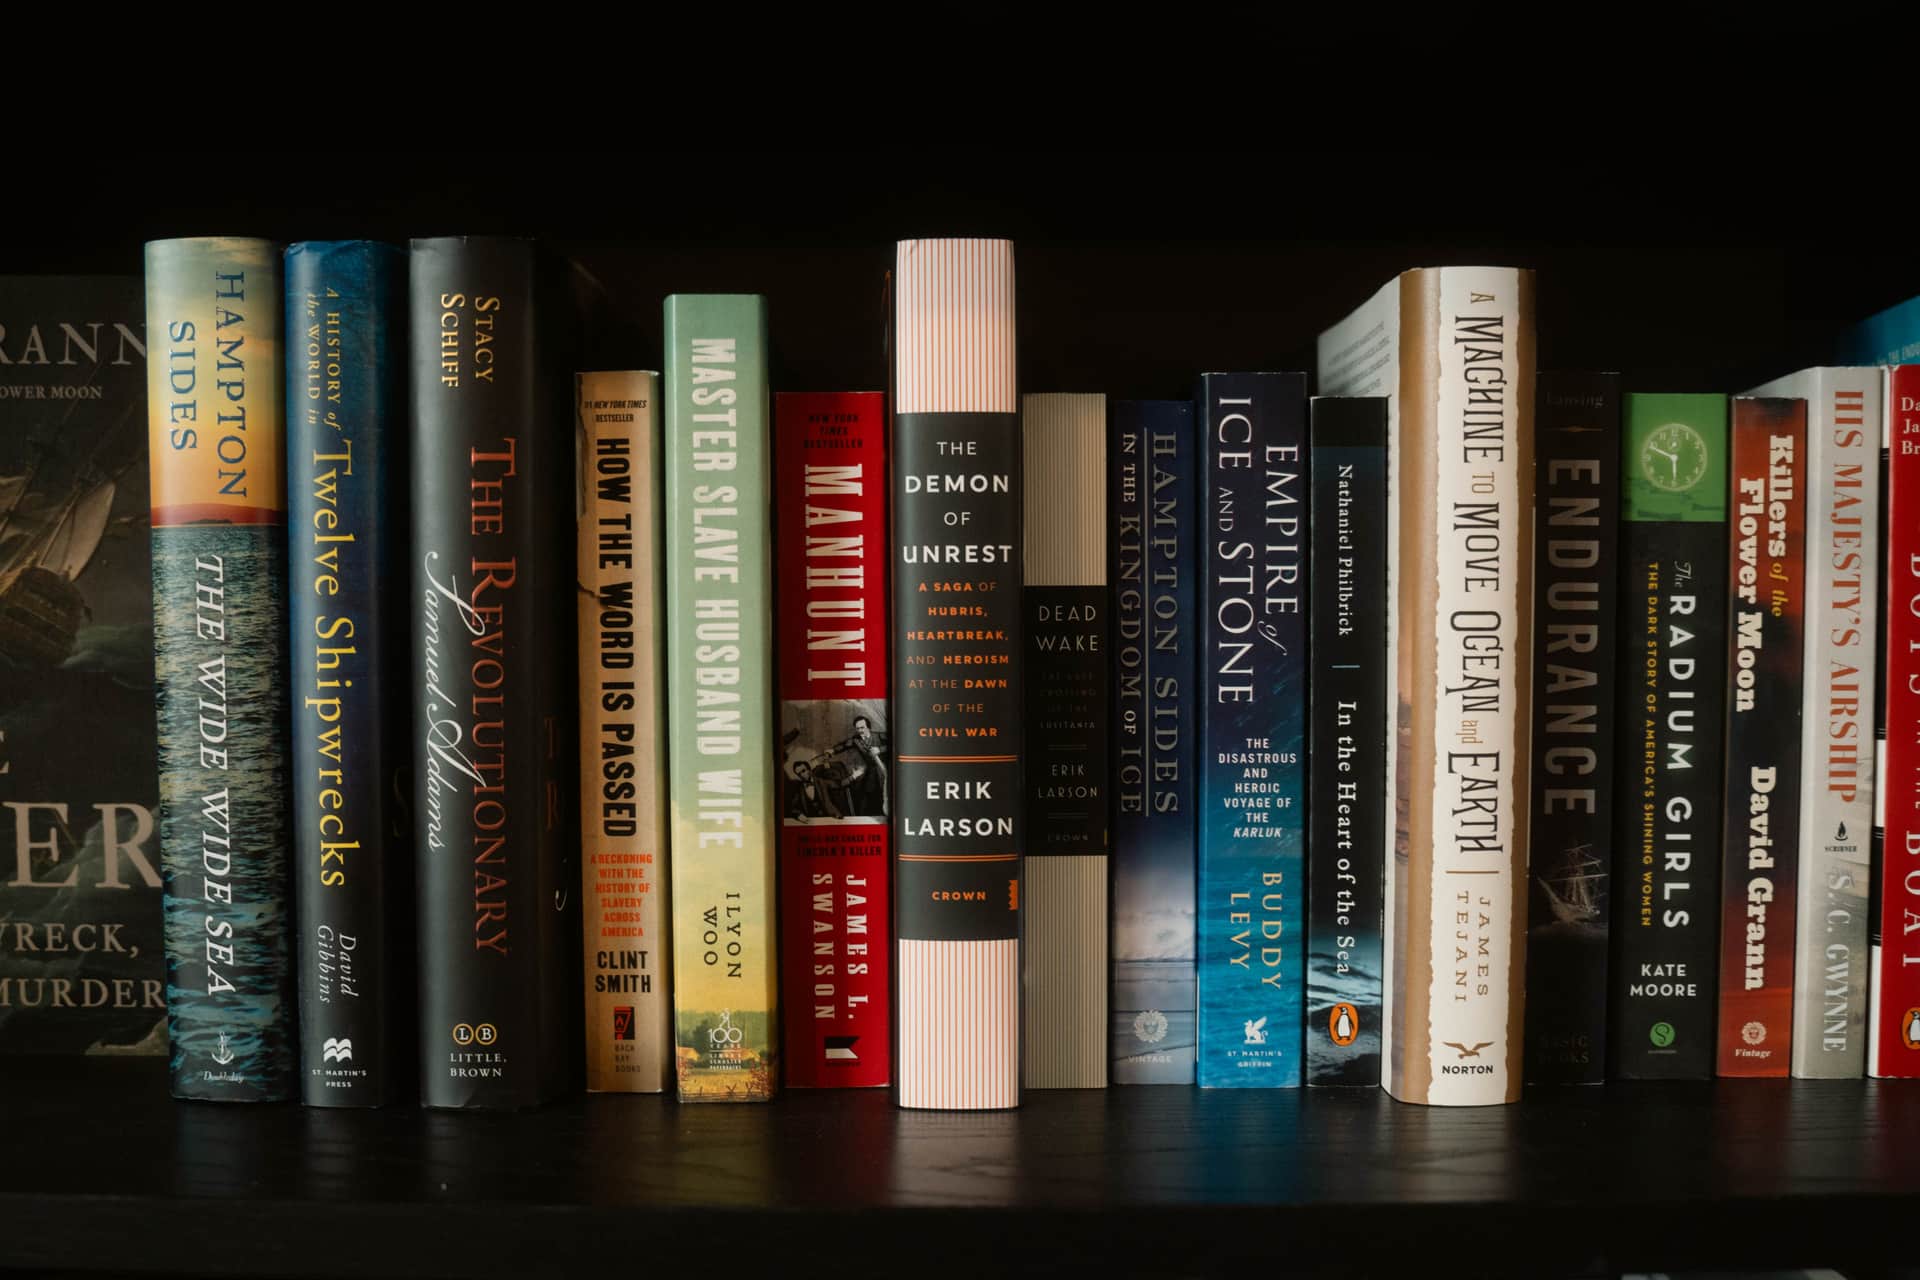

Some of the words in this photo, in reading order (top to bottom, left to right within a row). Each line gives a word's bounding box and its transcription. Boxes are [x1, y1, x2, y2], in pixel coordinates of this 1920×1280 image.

[307, 293, 316, 316] the
[327, 288, 339, 298] A
[1470, 292, 1495, 304] A
[307, 325, 321, 398] WORLD
[326, 312, 341, 399] HISTORY
[440, 293, 465, 387] SCHIFF
[474, 296, 501, 385] STACY
[51, 386, 103, 400] MOON
[169, 321, 197, 450] SIDES
[215, 271, 247, 497] HAMPTON
[692, 338, 737, 471] MASTER
[1454, 315, 1507, 463] MACHINE
[307, 409, 316, 425] in
[323, 413, 342, 431] of
[1218, 397, 1253, 469] ICE
[1833, 391, 1863, 448] HIS
[936, 442, 977, 455] THE
[1122, 432, 1137, 454] IN
[470, 438, 519, 535] THE
[597, 438, 630, 503] HOW
[904, 474, 1009, 493] DEMON
[1122, 464, 1136, 502] THE
[1471, 472, 1495, 494] TO
[313, 439, 356, 596] Twelve
[1218, 487, 1234, 532] AND
[1338, 464, 1353, 550] Nathaniel
[1769, 435, 1794, 557] Killers
[599, 514, 632, 569] THE
[693, 485, 738, 583] SLAVE
[943, 512, 971, 526] OF
[1265, 445, 1299, 614] EMPIRE
[1739, 478, 1764, 604] Flower
[903, 545, 1013, 563] UNREST
[1152, 432, 1177, 654] HAMPTON
[1453, 502, 1500, 592] MOVE
[1831, 464, 1863, 647] MAJESTY'S
[805, 463, 866, 687] MANHUNT
[918, 582, 927, 592] A
[933, 582, 973, 592] SAGA
[978, 582, 997, 592] OF
[1647, 562, 1659, 590] THE
[1674, 560, 1693, 588] The
[1771, 562, 1789, 582] of
[195, 555, 224, 641] THE
[928, 606, 988, 618] HUBRIS,
[1038, 604, 1097, 622] DEAD
[1120, 515, 1142, 699] KINGDOM
[1338, 558, 1353, 637] Philbrick
[1647, 597, 1658, 634] DARK
[1771, 590, 1789, 617] the
[425, 552, 486, 707] Samuel
[600, 582, 634, 669] WORD
[907, 631, 1009, 641] HEARTBREAK,
[1036, 634, 1099, 652] WAKE
[1217, 542, 1255, 704] STONE
[1257, 620, 1288, 656] of
[1543, 459, 1601, 816] ENDURANCE
[695, 600, 740, 755] HUSBAND
[906, 655, 935, 665] AND
[943, 654, 1009, 665] HEROISM
[1446, 610, 1504, 712] OCEAN
[1647, 641, 1657, 687] STORY
[1737, 612, 1763, 712] Moon
[601, 682, 634, 712] IS
[909, 679, 927, 689] AT
[931, 679, 957, 689] THE
[964, 679, 1008, 689] DAWN
[1646, 694, 1656, 713] OF
[1668, 595, 1697, 770] RADIUM
[198, 654, 228, 770] WIDE
[932, 703, 950, 713] OF
[957, 703, 984, 713] THE
[1122, 710, 1137, 735] OF
[1336, 700, 1357, 726] In
[305, 615, 361, 887] Shipwrecks
[919, 727, 958, 738] CIVIL
[965, 727, 999, 738] WAR
[1154, 677, 1178, 813] SIDES
[1246, 738, 1270, 749] THE
[1336, 733, 1357, 773] the
[1460, 719, 1483, 745] and
[1829, 661, 1858, 802] AIRSHIP
[426, 704, 486, 850] Adams
[470, 556, 518, 957] REVOLUTIONARY
[1051, 764, 1087, 777] ERIK
[1218, 753, 1297, 764] DISASTROUS
[1243, 768, 1268, 779] AND
[1644, 719, 1656, 798] AMERICA'S
[602, 724, 636, 837] PASSED
[926, 782, 993, 800] ERIK
[1037, 785, 1099, 799] LARSON
[1120, 746, 1143, 813] ICE
[1234, 783, 1281, 794] HEROIC
[1447, 751, 1504, 853] EARTH
[697, 769, 743, 849] WIFE
[1223, 797, 1273, 809] VOYAGE
[1276, 797, 1292, 809] OF
[1246, 813, 1270, 824] THE
[1336, 782, 1357, 849] Heart
[1749, 766, 1776, 870] David
[7, 801, 163, 889] ER
[201, 788, 232, 904] WIDE
[904, 818, 1013, 836] LARSON
[1233, 827, 1283, 839] KARLUK
[1642, 803, 1654, 865] SHINING
[598, 854, 652, 864] RECKONING
[600, 869, 622, 879] WITH
[625, 869, 644, 879] THE
[1336, 857, 1357, 884] of
[1663, 797, 1693, 927] GIRLS
[596, 884, 637, 893] HISTORY
[639, 884, 650, 893] OF
[601, 899, 642, 908] SLAVERY
[932, 891, 987, 901] CROWN
[1336, 889, 1357, 927] the
[1640, 871, 1653, 926] WOMEN
[601, 927, 644, 937] AMERICA
[604, 913, 640, 923] ACROSS
[703, 906, 718, 966] WOO
[726, 892, 741, 979] ILYON
[845, 873, 868, 975] JAMES
[1229, 892, 1251, 970] LEVY
[1261, 872, 1283, 990] BUDDY
[1745, 878, 1774, 991] Grann
[1826, 909, 1851, 933] C.
[205, 916, 236, 996] SEA
[317, 924, 334, 1004] Gibbins
[338, 933, 358, 997] David
[597, 951, 648, 968] CLINT
[812, 872, 836, 1020] SWANSON
[1336, 936, 1356, 974] Sea
[1455, 891, 1469, 1002] TEJANI
[1477, 896, 1490, 997] JAMES
[595, 975, 651, 993] SMITH
[1629, 983, 1697, 997] MOORE
[1641, 964, 1686, 977] KATE
[847, 994, 868, 1020] L.
[1823, 944, 1849, 1052] GWYNNE
[450, 1053, 508, 1064] LITTLE,
[450, 1067, 503, 1077] BROWN
[1128, 1055, 1173, 1063] VINTAGE
[1442, 1064, 1493, 1075] NORTON
[1735, 1049, 1771, 1058] Vintage
